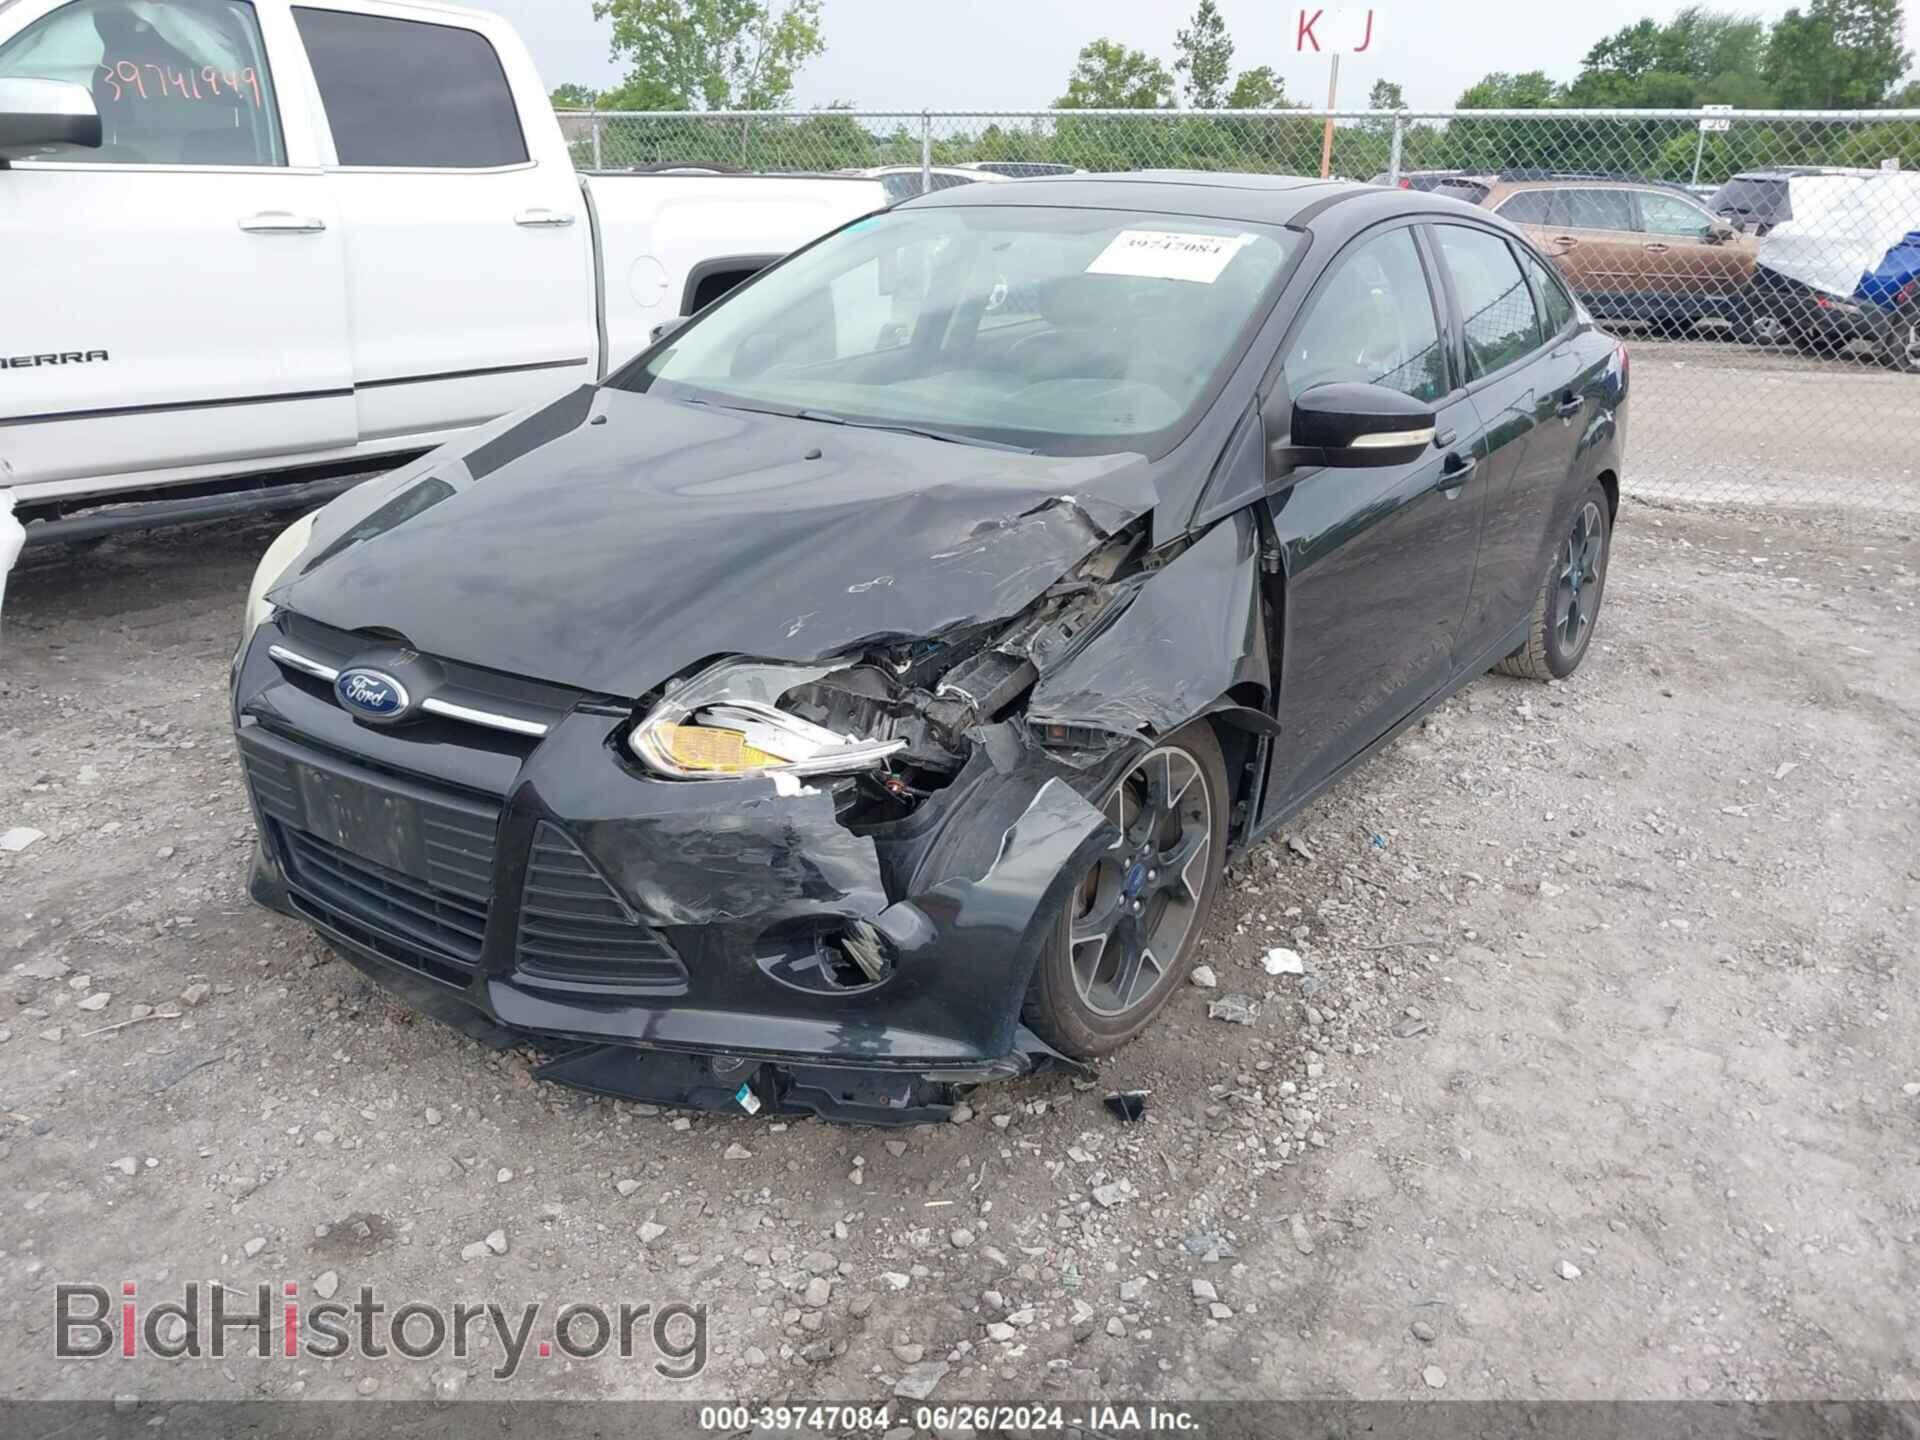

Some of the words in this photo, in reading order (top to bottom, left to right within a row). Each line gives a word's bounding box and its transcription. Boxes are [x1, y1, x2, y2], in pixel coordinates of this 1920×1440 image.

[1297, 9, 1323, 52] K
[1353, 9, 1373, 52] J
[0, 350, 109, 369] IERRA
[346, 675, 388, 707] Ford
